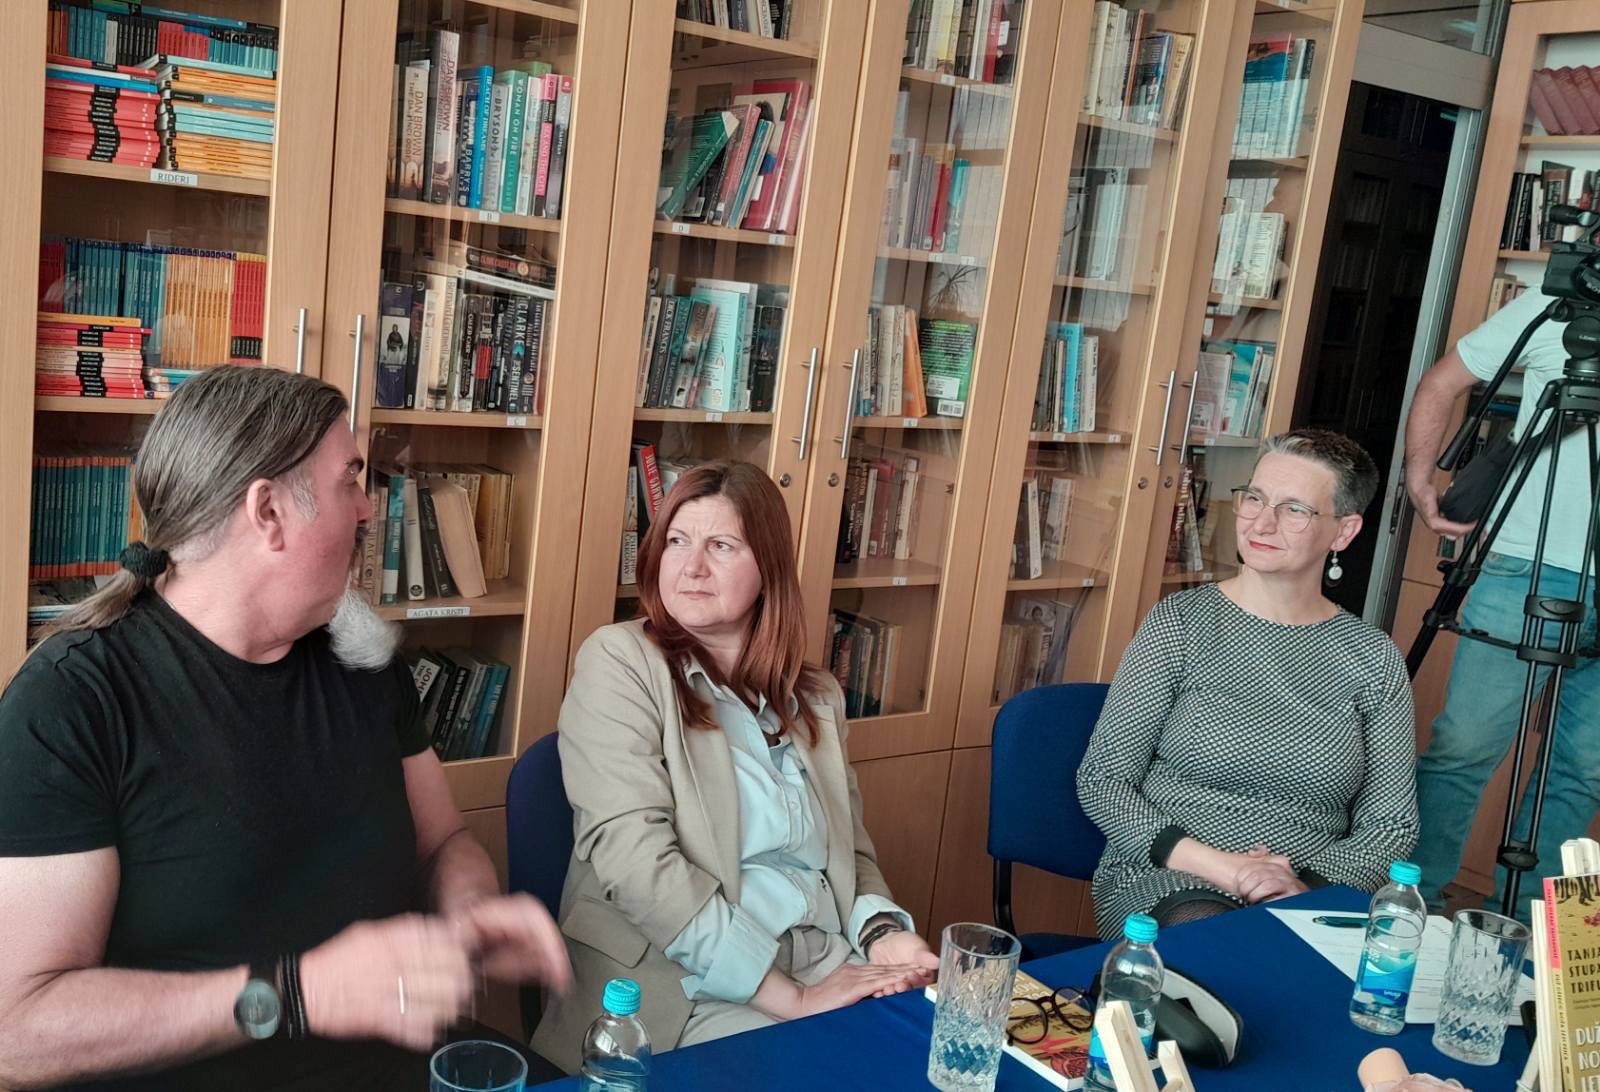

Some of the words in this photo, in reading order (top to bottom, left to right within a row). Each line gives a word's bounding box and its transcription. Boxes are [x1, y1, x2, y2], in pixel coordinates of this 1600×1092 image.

[414, 91, 425, 114] DAN
[514, 78, 524, 115] WOMAN
[491, 97, 502, 145] BRYSON
[512, 118, 520, 130] ON
[412, 115, 423, 157] BROWN
[510, 136, 519, 156] FIRE
[158, 172, 190, 184] RIDERI
[462, 149, 472, 192] BARRY'S
[665, 300, 675, 321] DICK
[514, 303, 528, 345] CLARKE
[659, 321, 671, 354] FRANCIS
[509, 366, 520, 402] SENTINEL
[645, 452, 658, 475] JULIE
[412, 609, 441, 618] AGATA
[1567, 946, 1600, 961] TANJ
